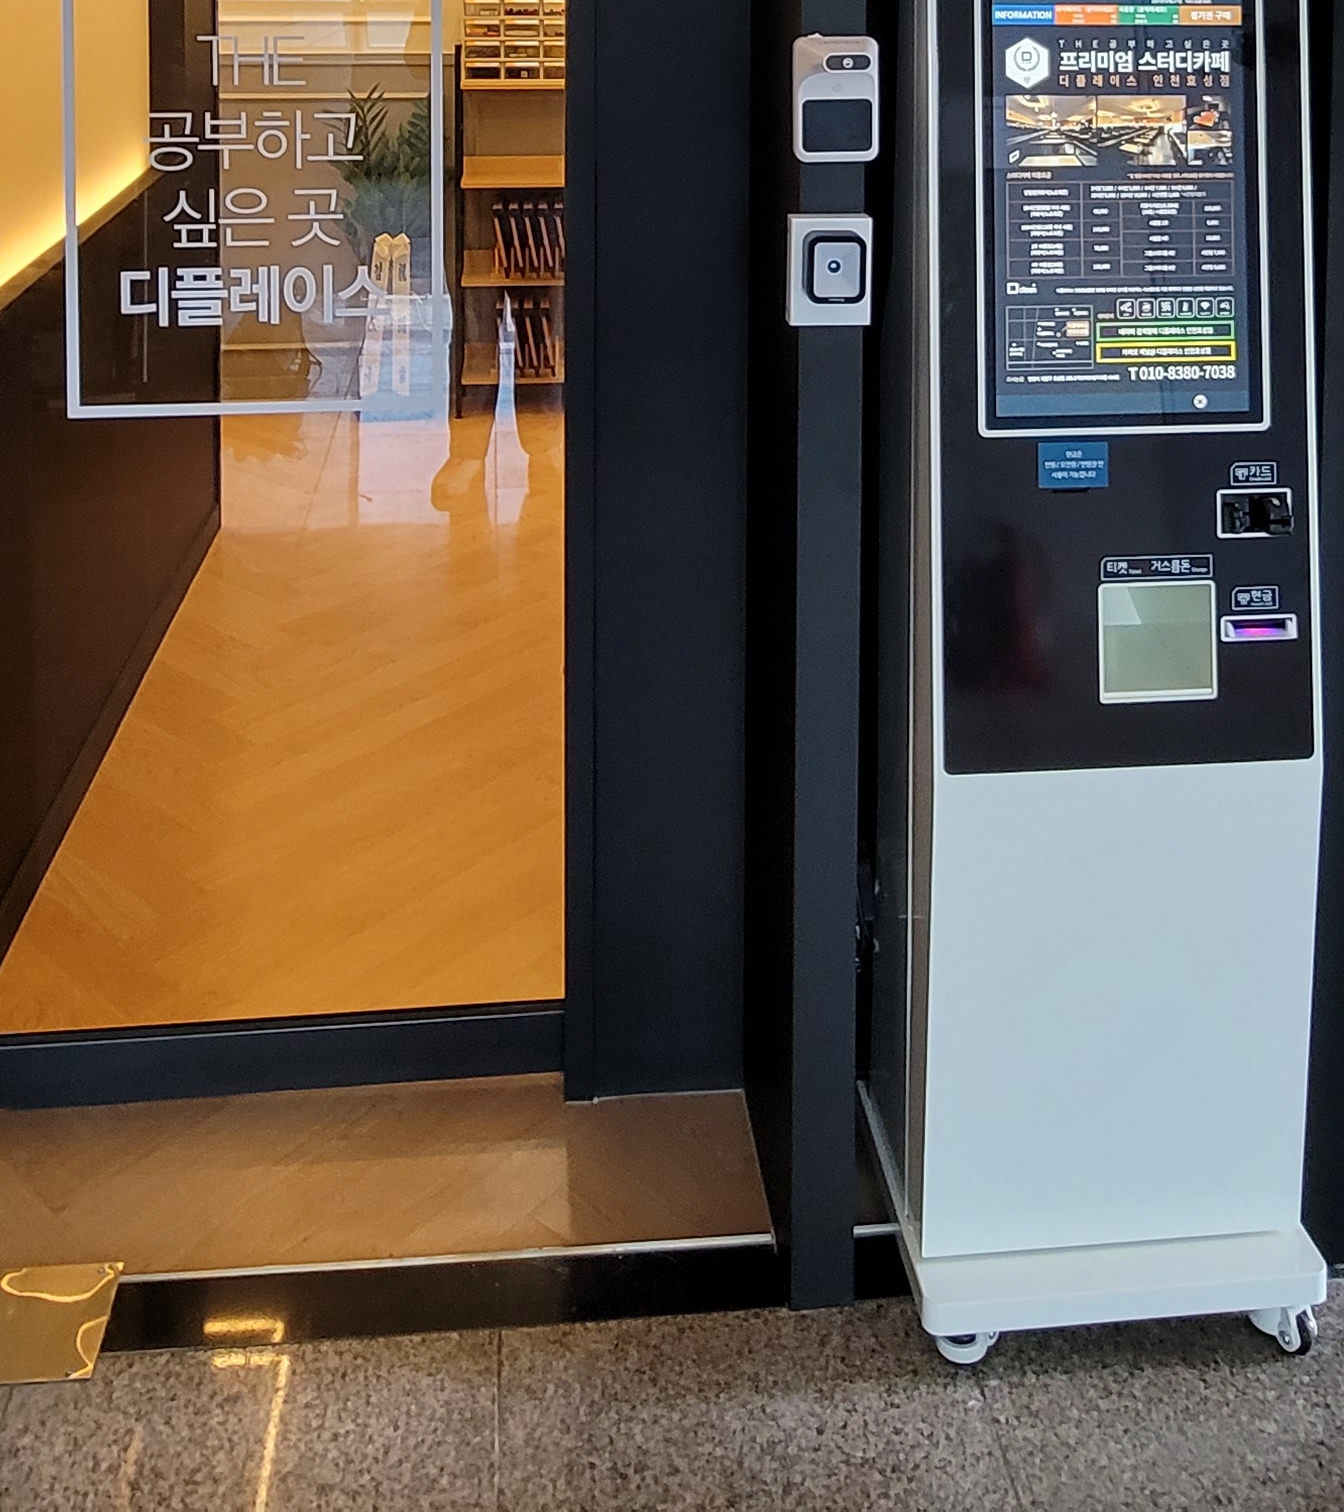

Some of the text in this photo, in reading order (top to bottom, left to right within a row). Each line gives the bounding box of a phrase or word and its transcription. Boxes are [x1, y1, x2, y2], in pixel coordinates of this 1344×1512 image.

[994, 10, 1053, 20] INFORMATION
[197, 36, 307, 87] THE
[1059, 51, 1231, 73] 프리미엄 스터디카페
[1059, 74, 1231, 88] 디플레이스 인천효성점
[143, 110, 364, 172] 공부하고
[163, 187, 345, 248] 싶은 곳
[119, 264, 392, 328] 디플레이스
[1128, 367, 1138, 381] T
[1139, 365, 1236, 380] 010-8380-7038
[1249, 465, 1272, 478] 카드
[1106, 559, 1191, 575] 티켓 거스름돈
[1250, 590, 1273, 603] 현금
